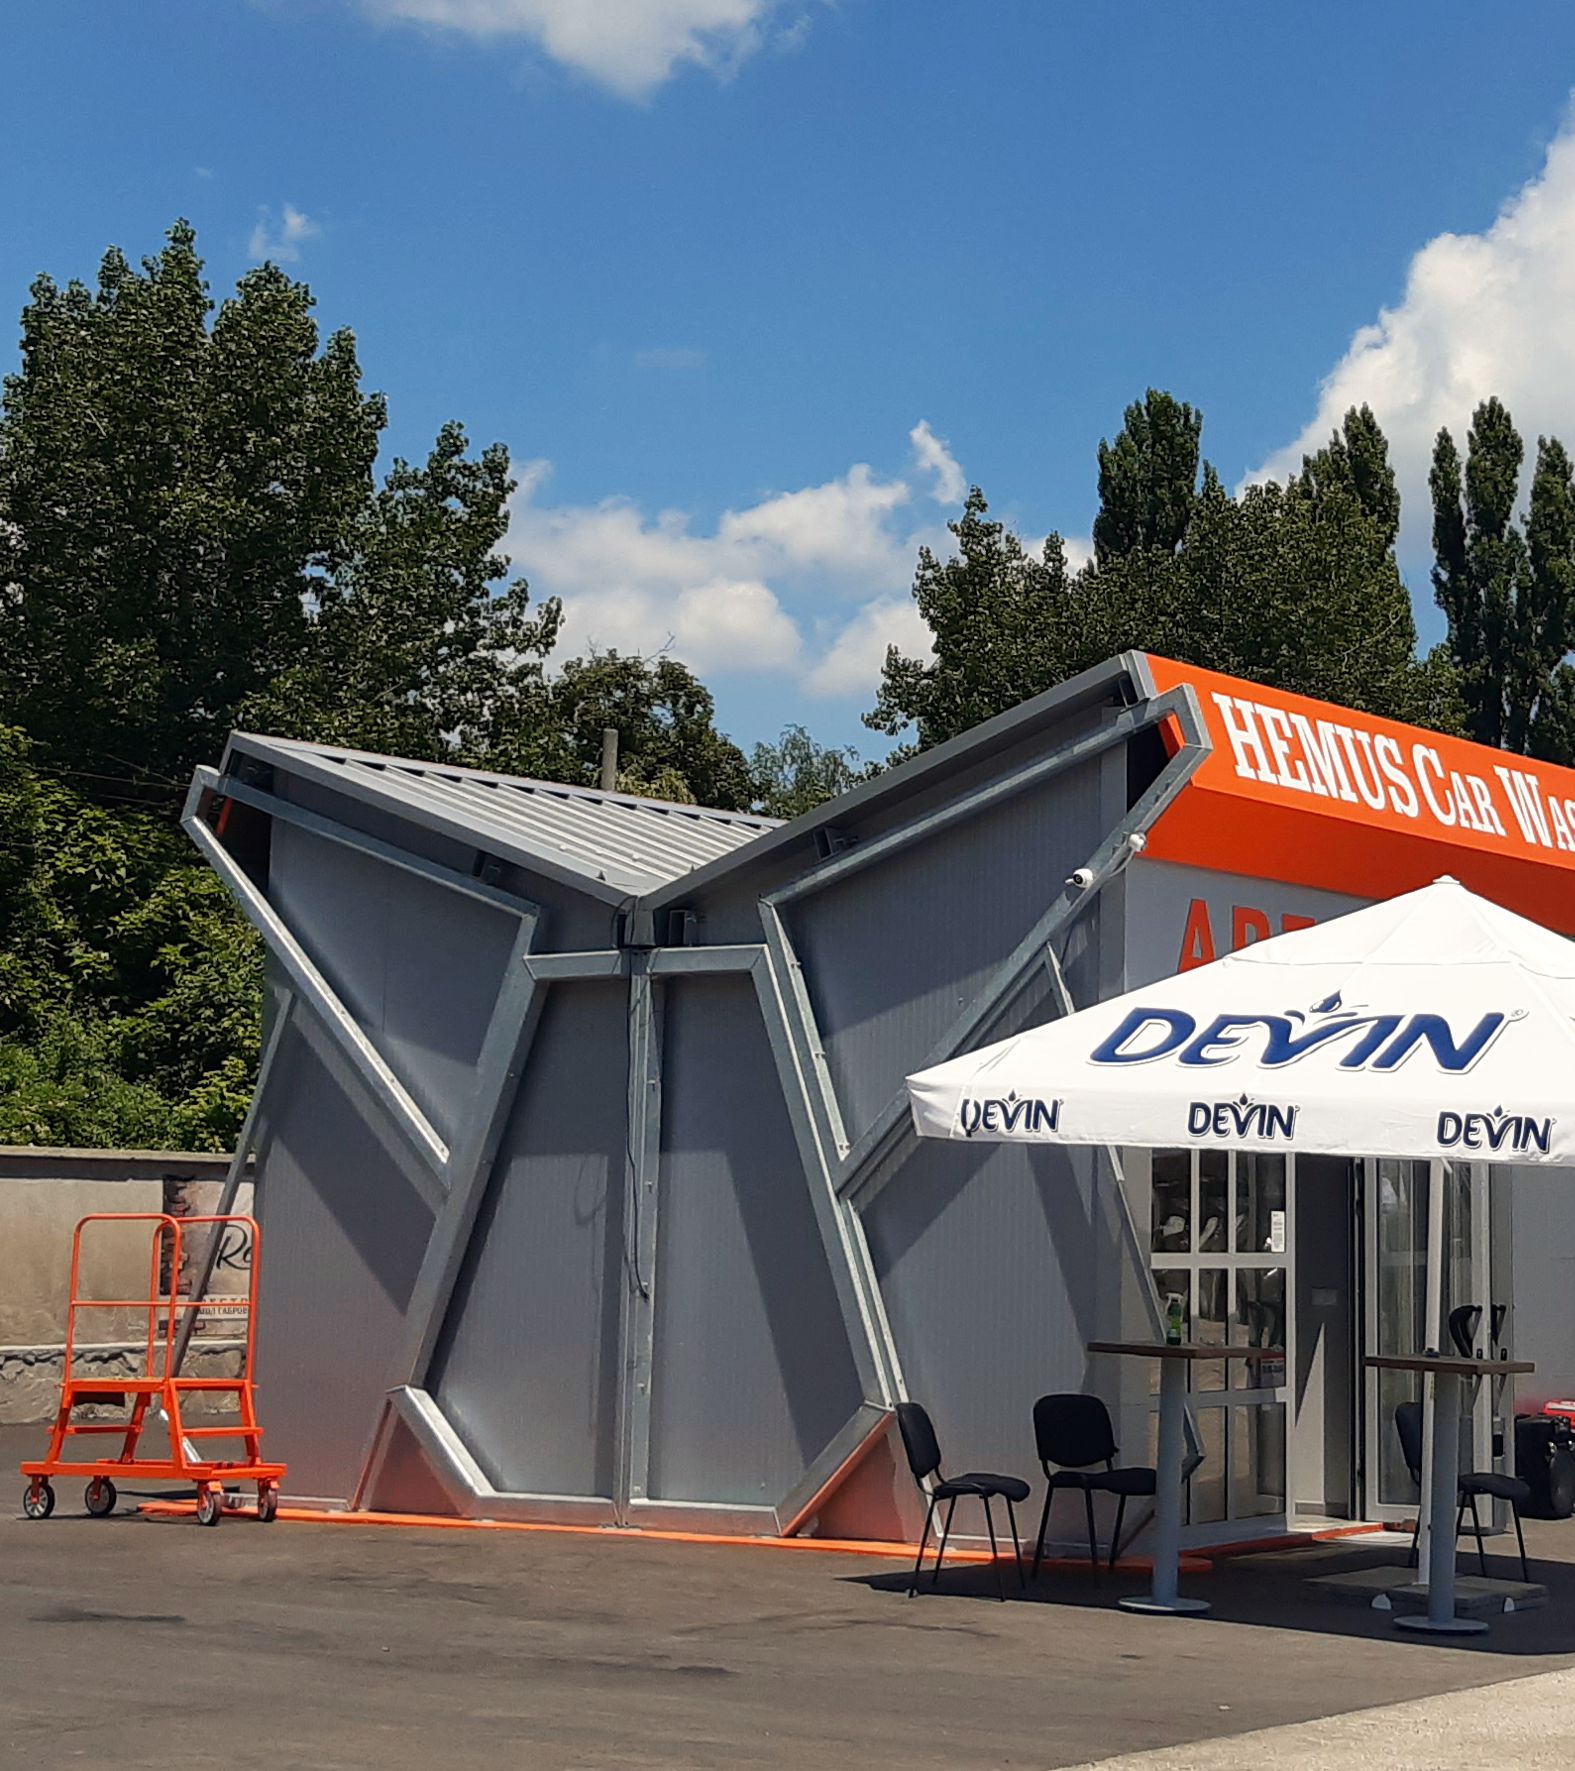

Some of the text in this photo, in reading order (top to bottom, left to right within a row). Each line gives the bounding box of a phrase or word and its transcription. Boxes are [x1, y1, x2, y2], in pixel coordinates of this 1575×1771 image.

[1211, 692, 1421, 818] HEMUS
[1088, 1006, 1505, 1073] DEVIN
[961, 1098, 1060, 1134] DEVIN
[1187, 1101, 1295, 1139] DEVIN
[1436, 1111, 1550, 1153] DEVIN
